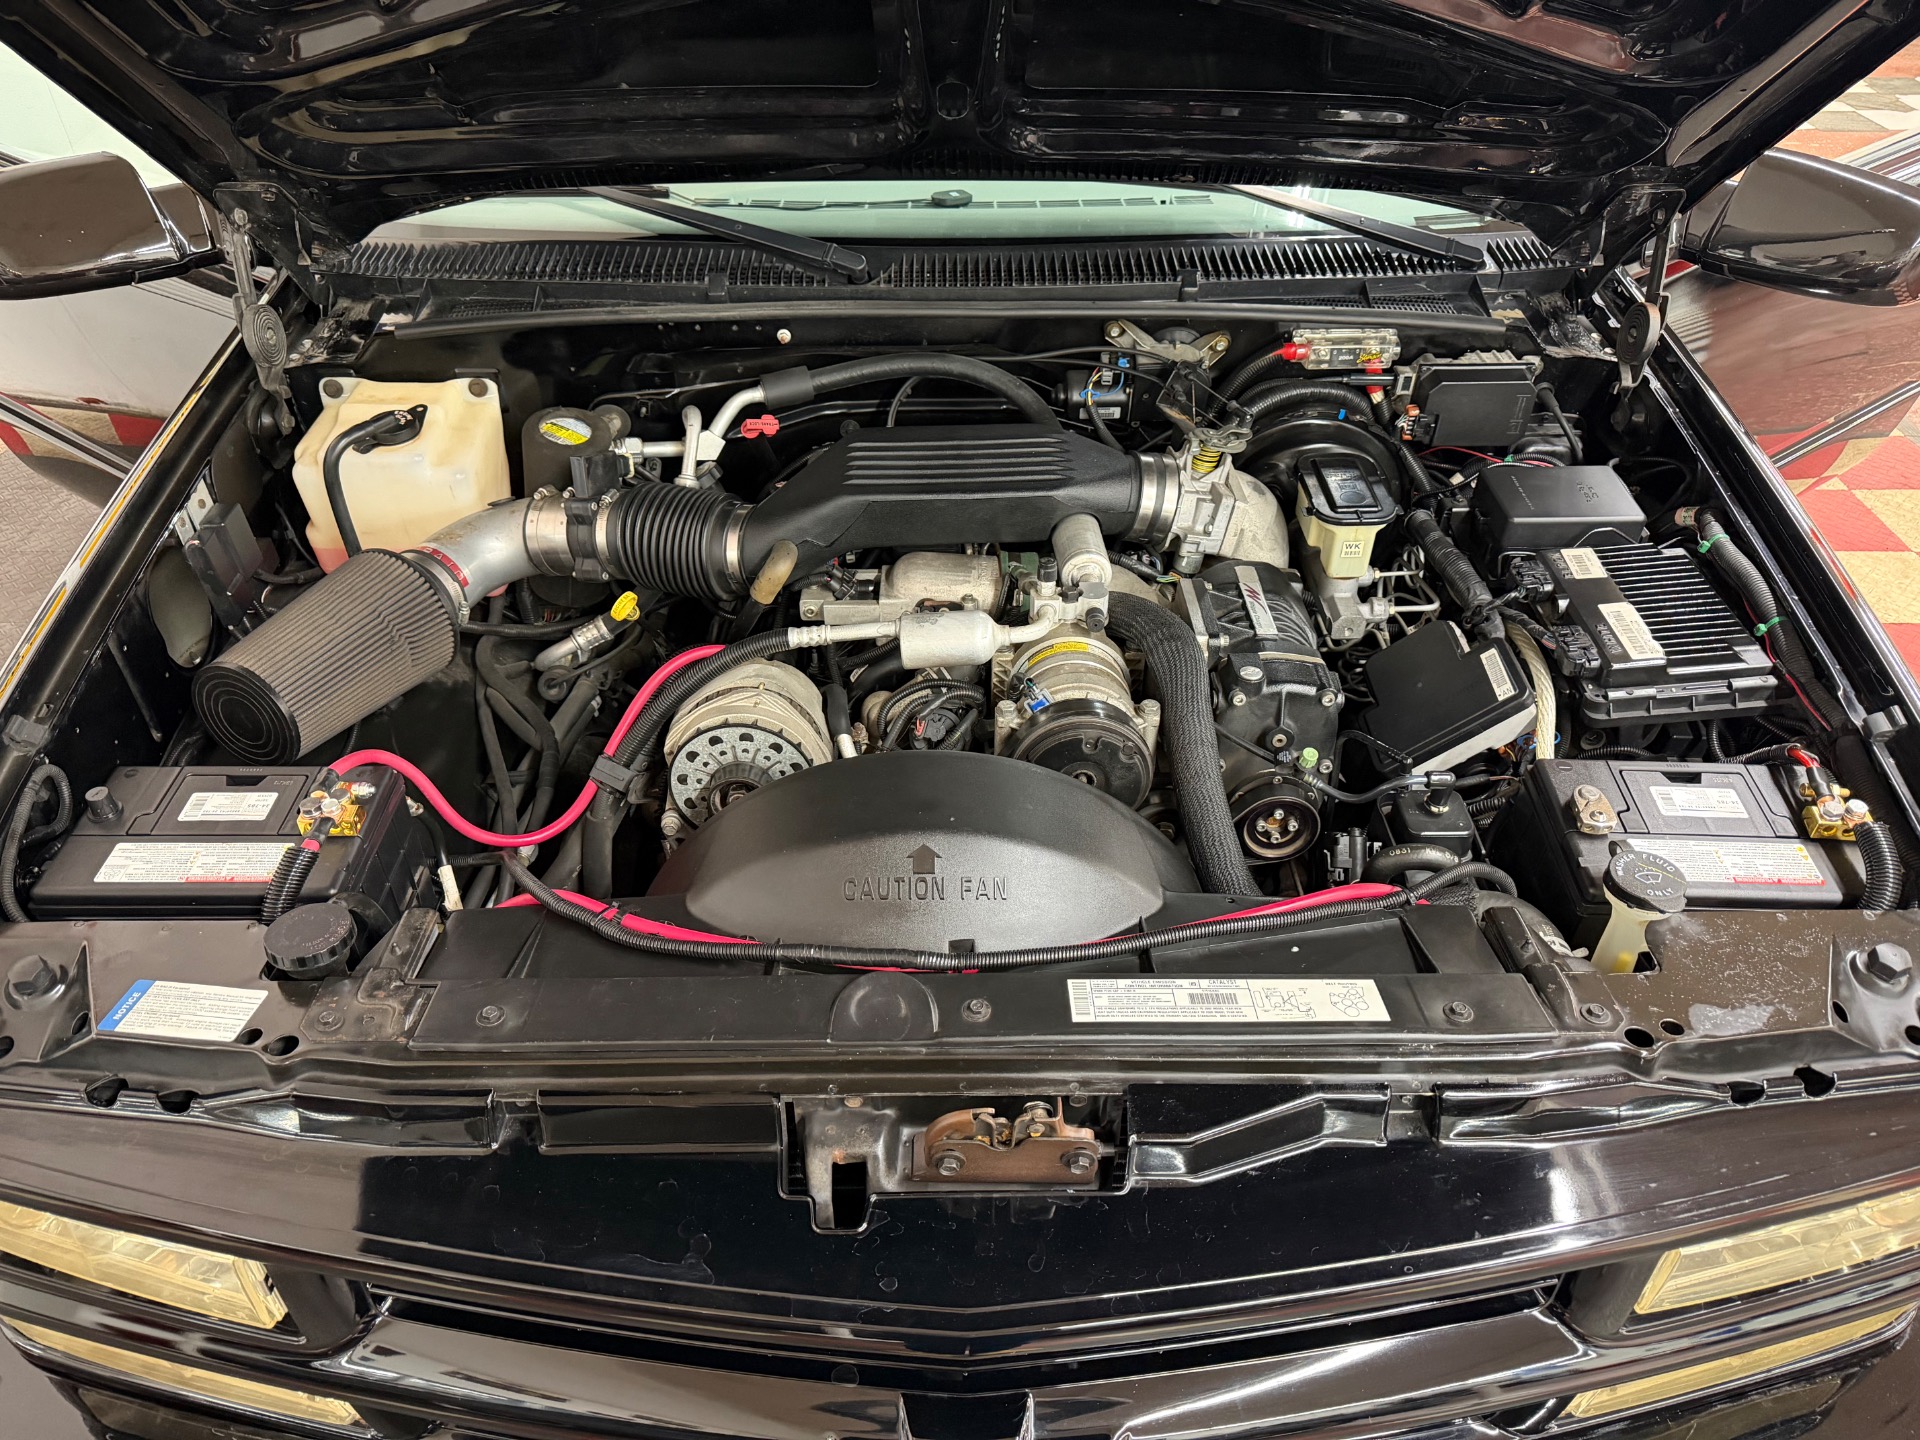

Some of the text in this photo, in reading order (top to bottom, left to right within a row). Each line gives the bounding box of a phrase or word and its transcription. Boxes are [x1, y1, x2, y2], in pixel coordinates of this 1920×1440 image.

[1389, 847, 1411, 856] 0831
[1615, 852, 1636, 876] WASHER
[1642, 853, 1675, 872] FLUID
[843, 876, 1008, 901] CAUTION FAN
[1646, 887, 1675, 897] ONLY
[112, 991, 141, 1021] NOTICE
